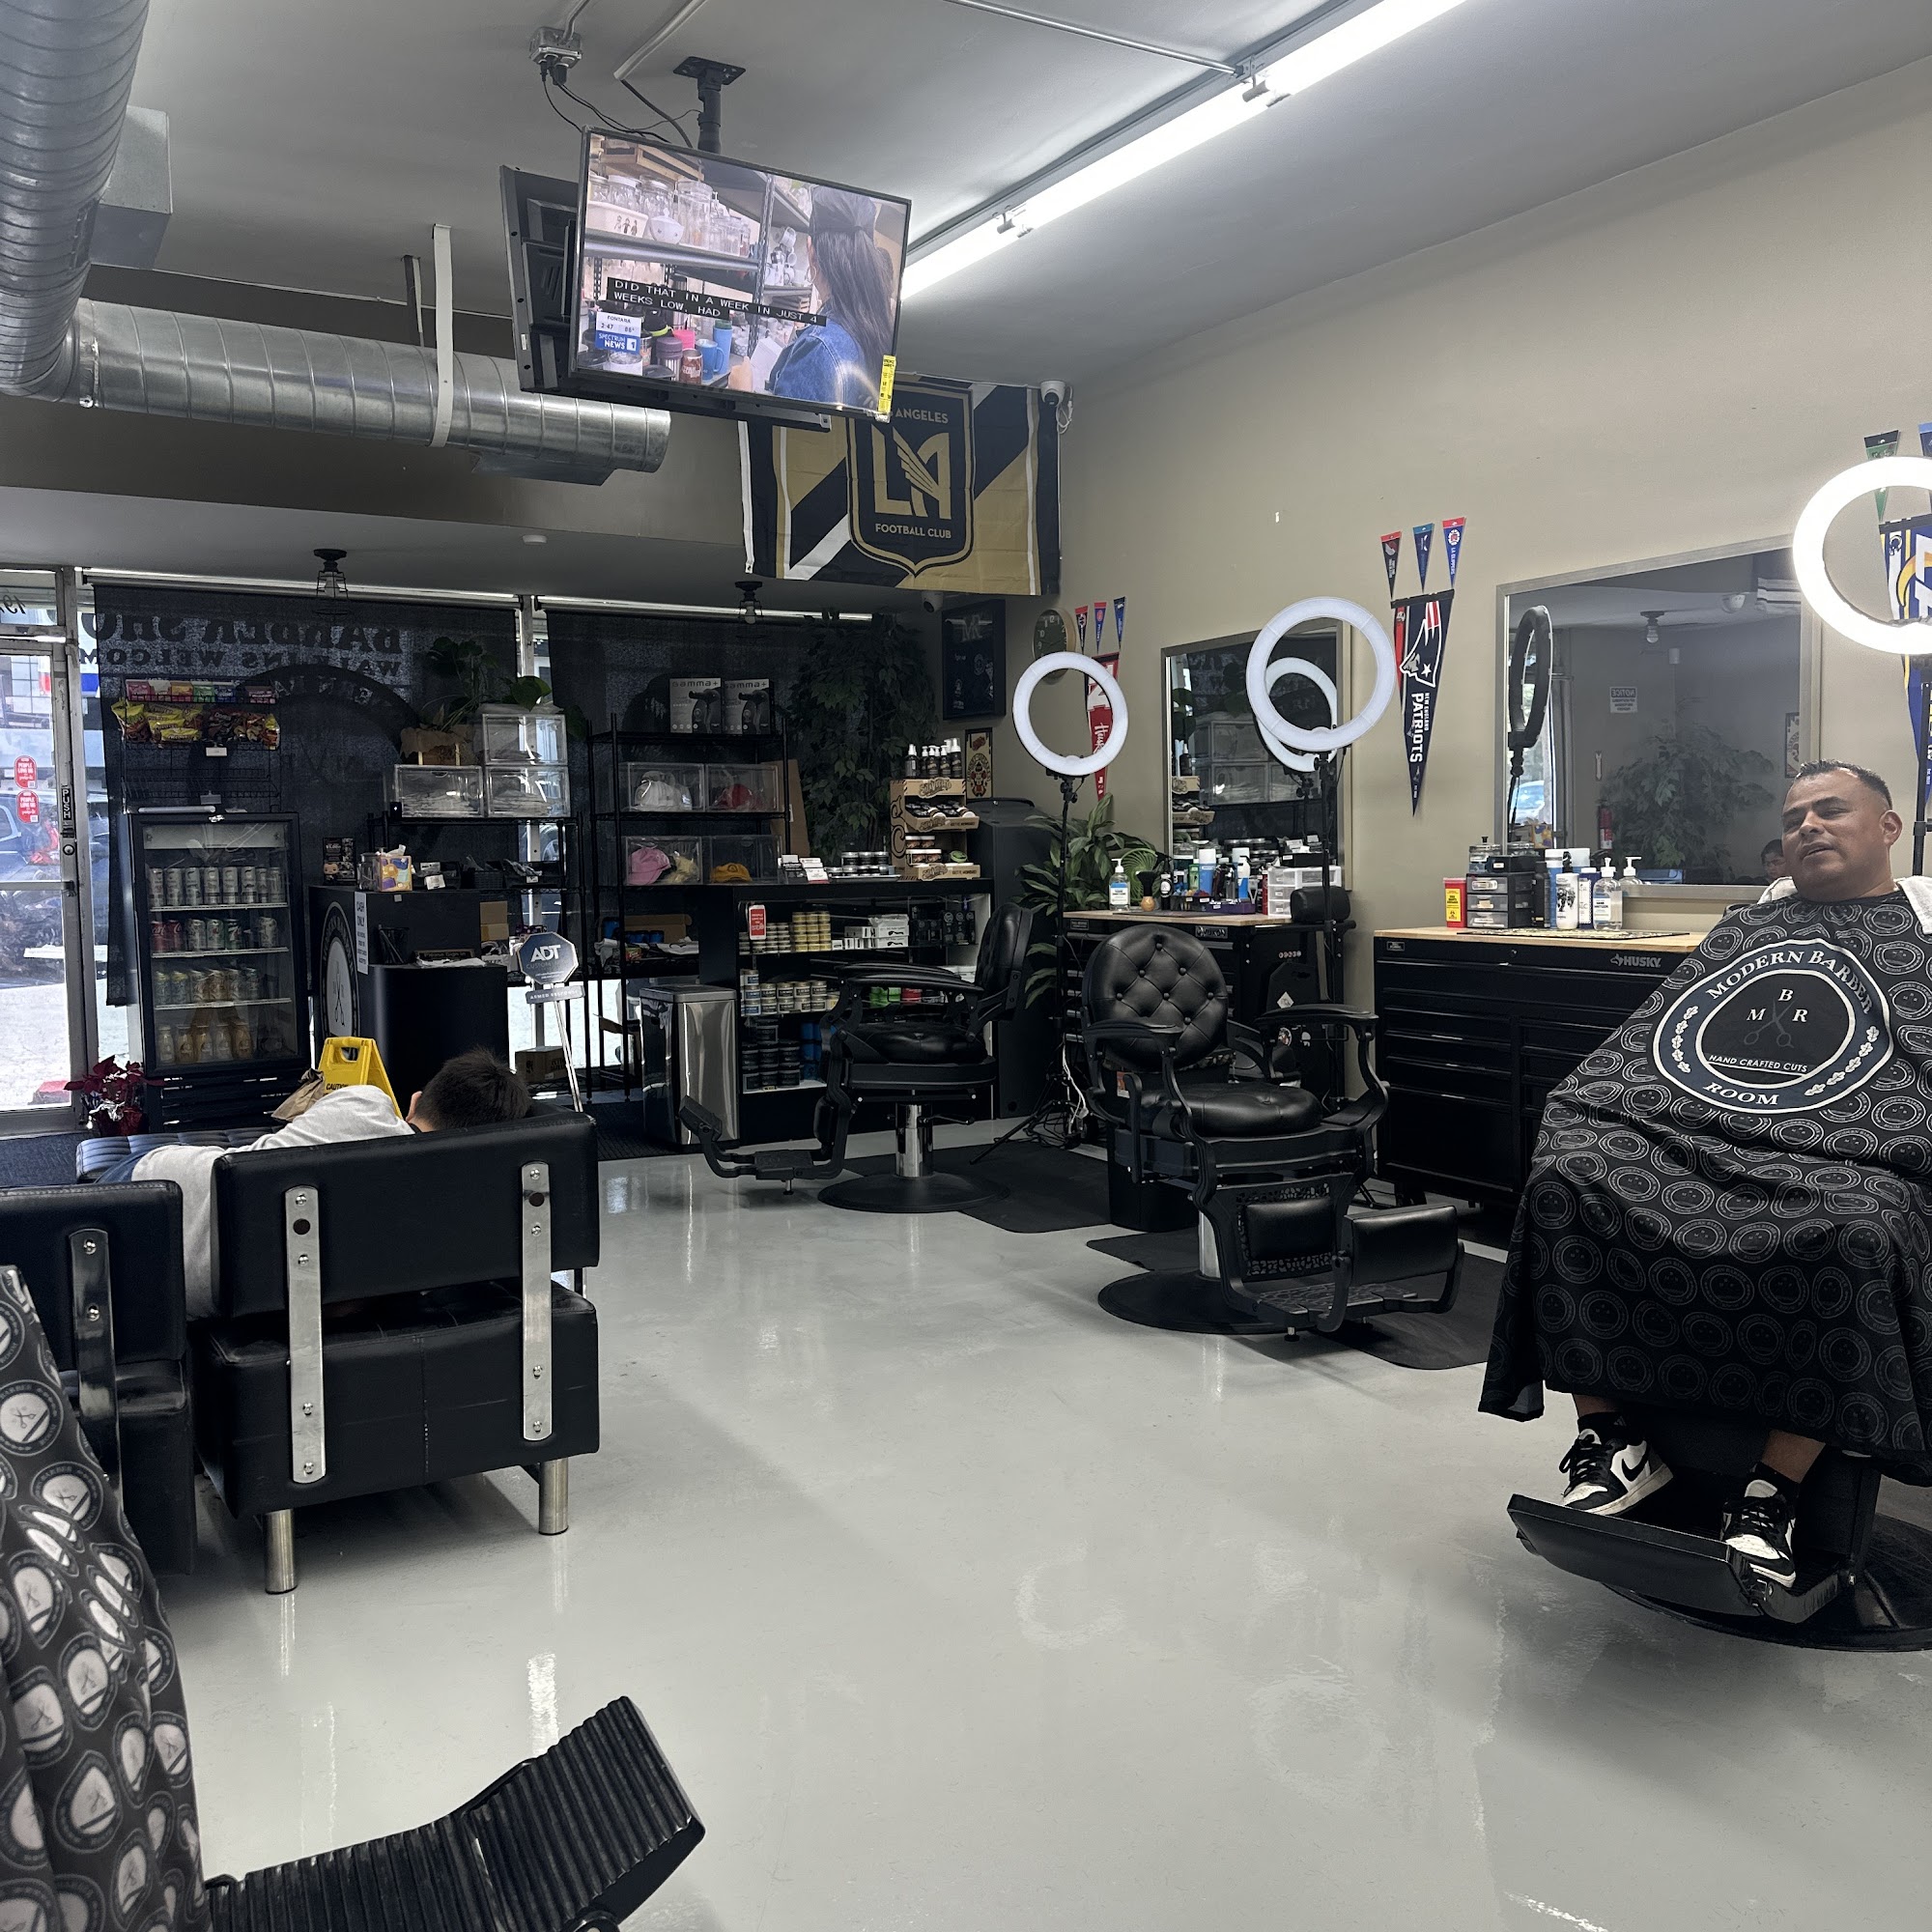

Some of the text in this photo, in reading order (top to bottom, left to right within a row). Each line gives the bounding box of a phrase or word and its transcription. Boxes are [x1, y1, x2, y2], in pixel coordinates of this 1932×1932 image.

[613, 292, 653, 305] WEEKS
[697, 306, 721, 317] HAD
[614, 280, 817, 324] DID THAT IN A WEEK IN JUST 4
[604, 339, 626, 350] NEWS
[895, 408, 950, 424] ANGELES
[875, 523, 952, 539] FOOTBALL CLUB
[1409, 693, 1425, 762] PATRIOTS
[62, 789, 71, 819] PUSH
[530, 944, 561, 962] ADT
[1623, 954, 1662, 969] HUSKY
[1705, 951, 1804, 1000] MODERN
[1807, 951, 1873, 1014] BARBER
[1777, 988, 1794, 1002] B
[1746, 1008, 1808, 1022] M R
[1709, 1055, 1808, 1073] HAND CRAFTED CUTS
[1703, 1082, 1779, 1105] ROOM
